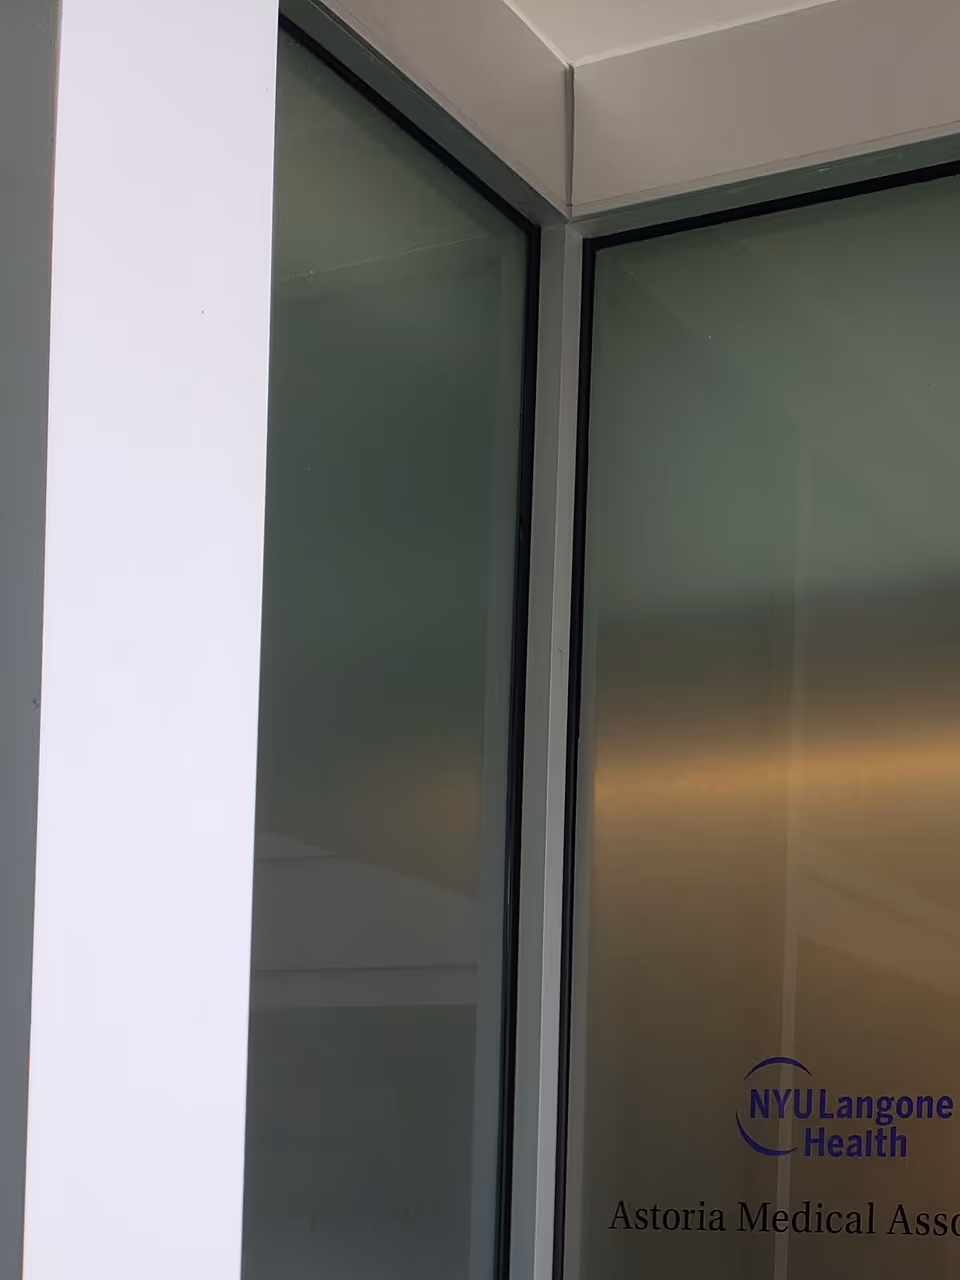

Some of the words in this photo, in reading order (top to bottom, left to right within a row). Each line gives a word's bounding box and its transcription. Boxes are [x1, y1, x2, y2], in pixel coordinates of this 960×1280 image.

[750, 1088, 813, 1119] NYU
[819, 1088, 954, 1126] Langone
[804, 1126, 907, 1157] Health
[608, 1200, 726, 1231] Astoria
[736, 1200, 877, 1235] Medical
